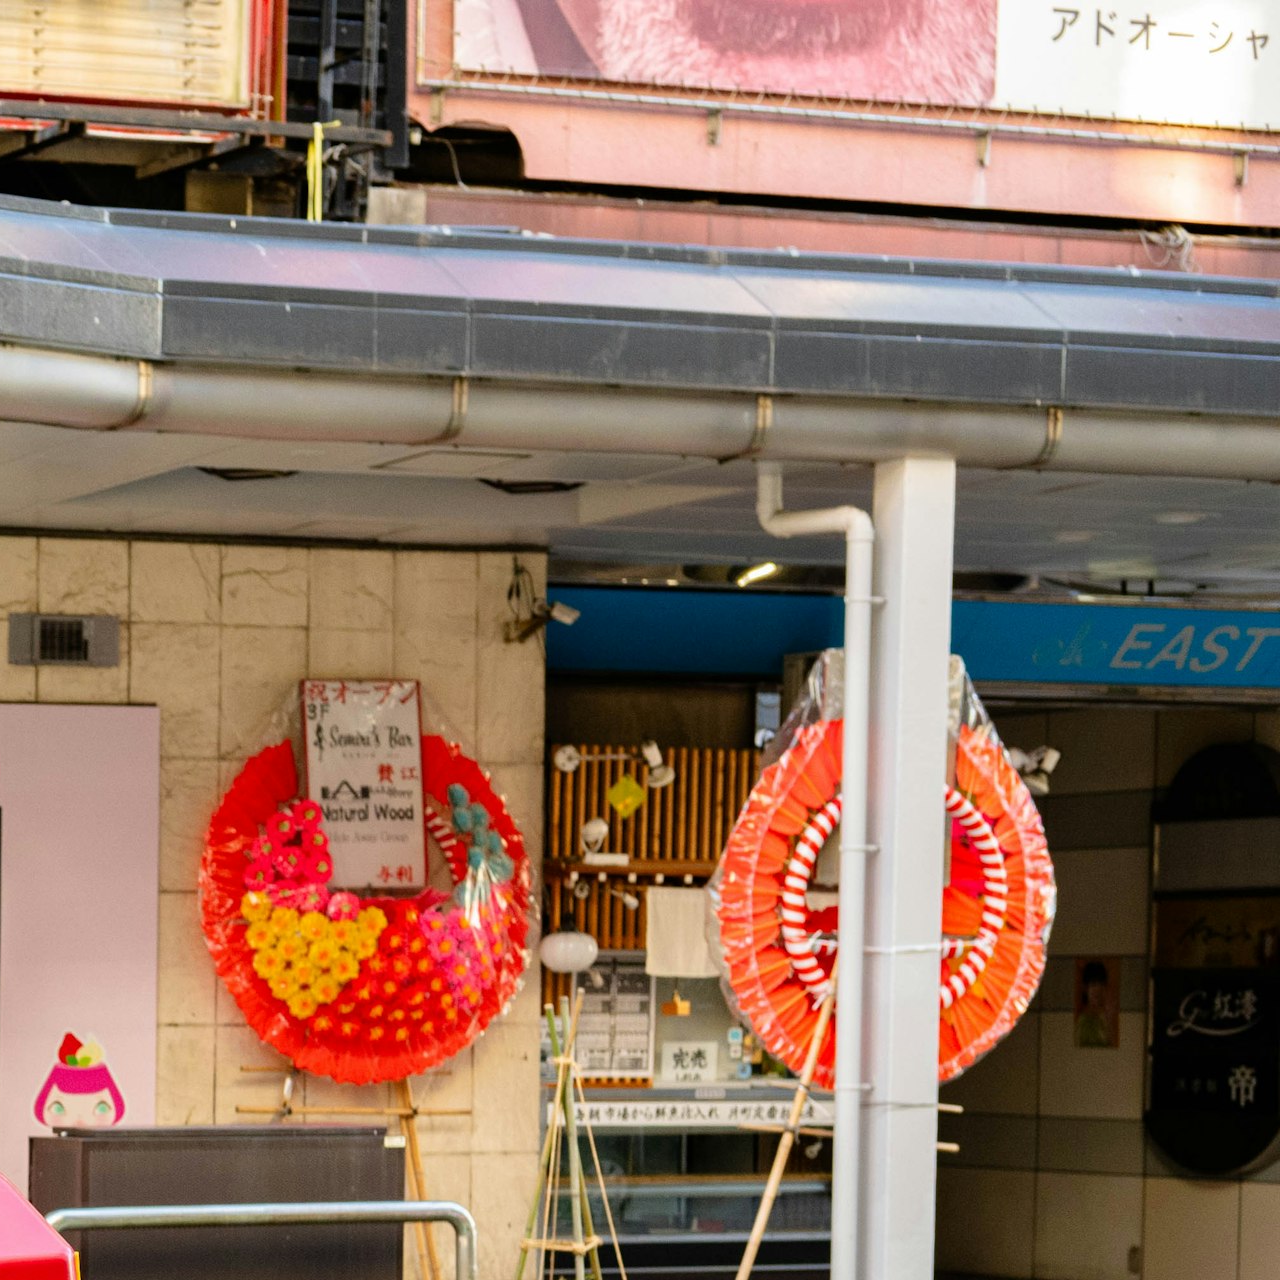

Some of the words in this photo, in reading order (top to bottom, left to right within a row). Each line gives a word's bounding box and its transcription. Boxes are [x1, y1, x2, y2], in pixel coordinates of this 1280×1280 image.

[1052, 7, 1269, 60] アドオーシャ
[1109, 622, 1280, 673] EAST
[307, 703, 329, 720] 3F
[320, 802, 369, 822] Natural
[374, 804, 414, 821] Wood
